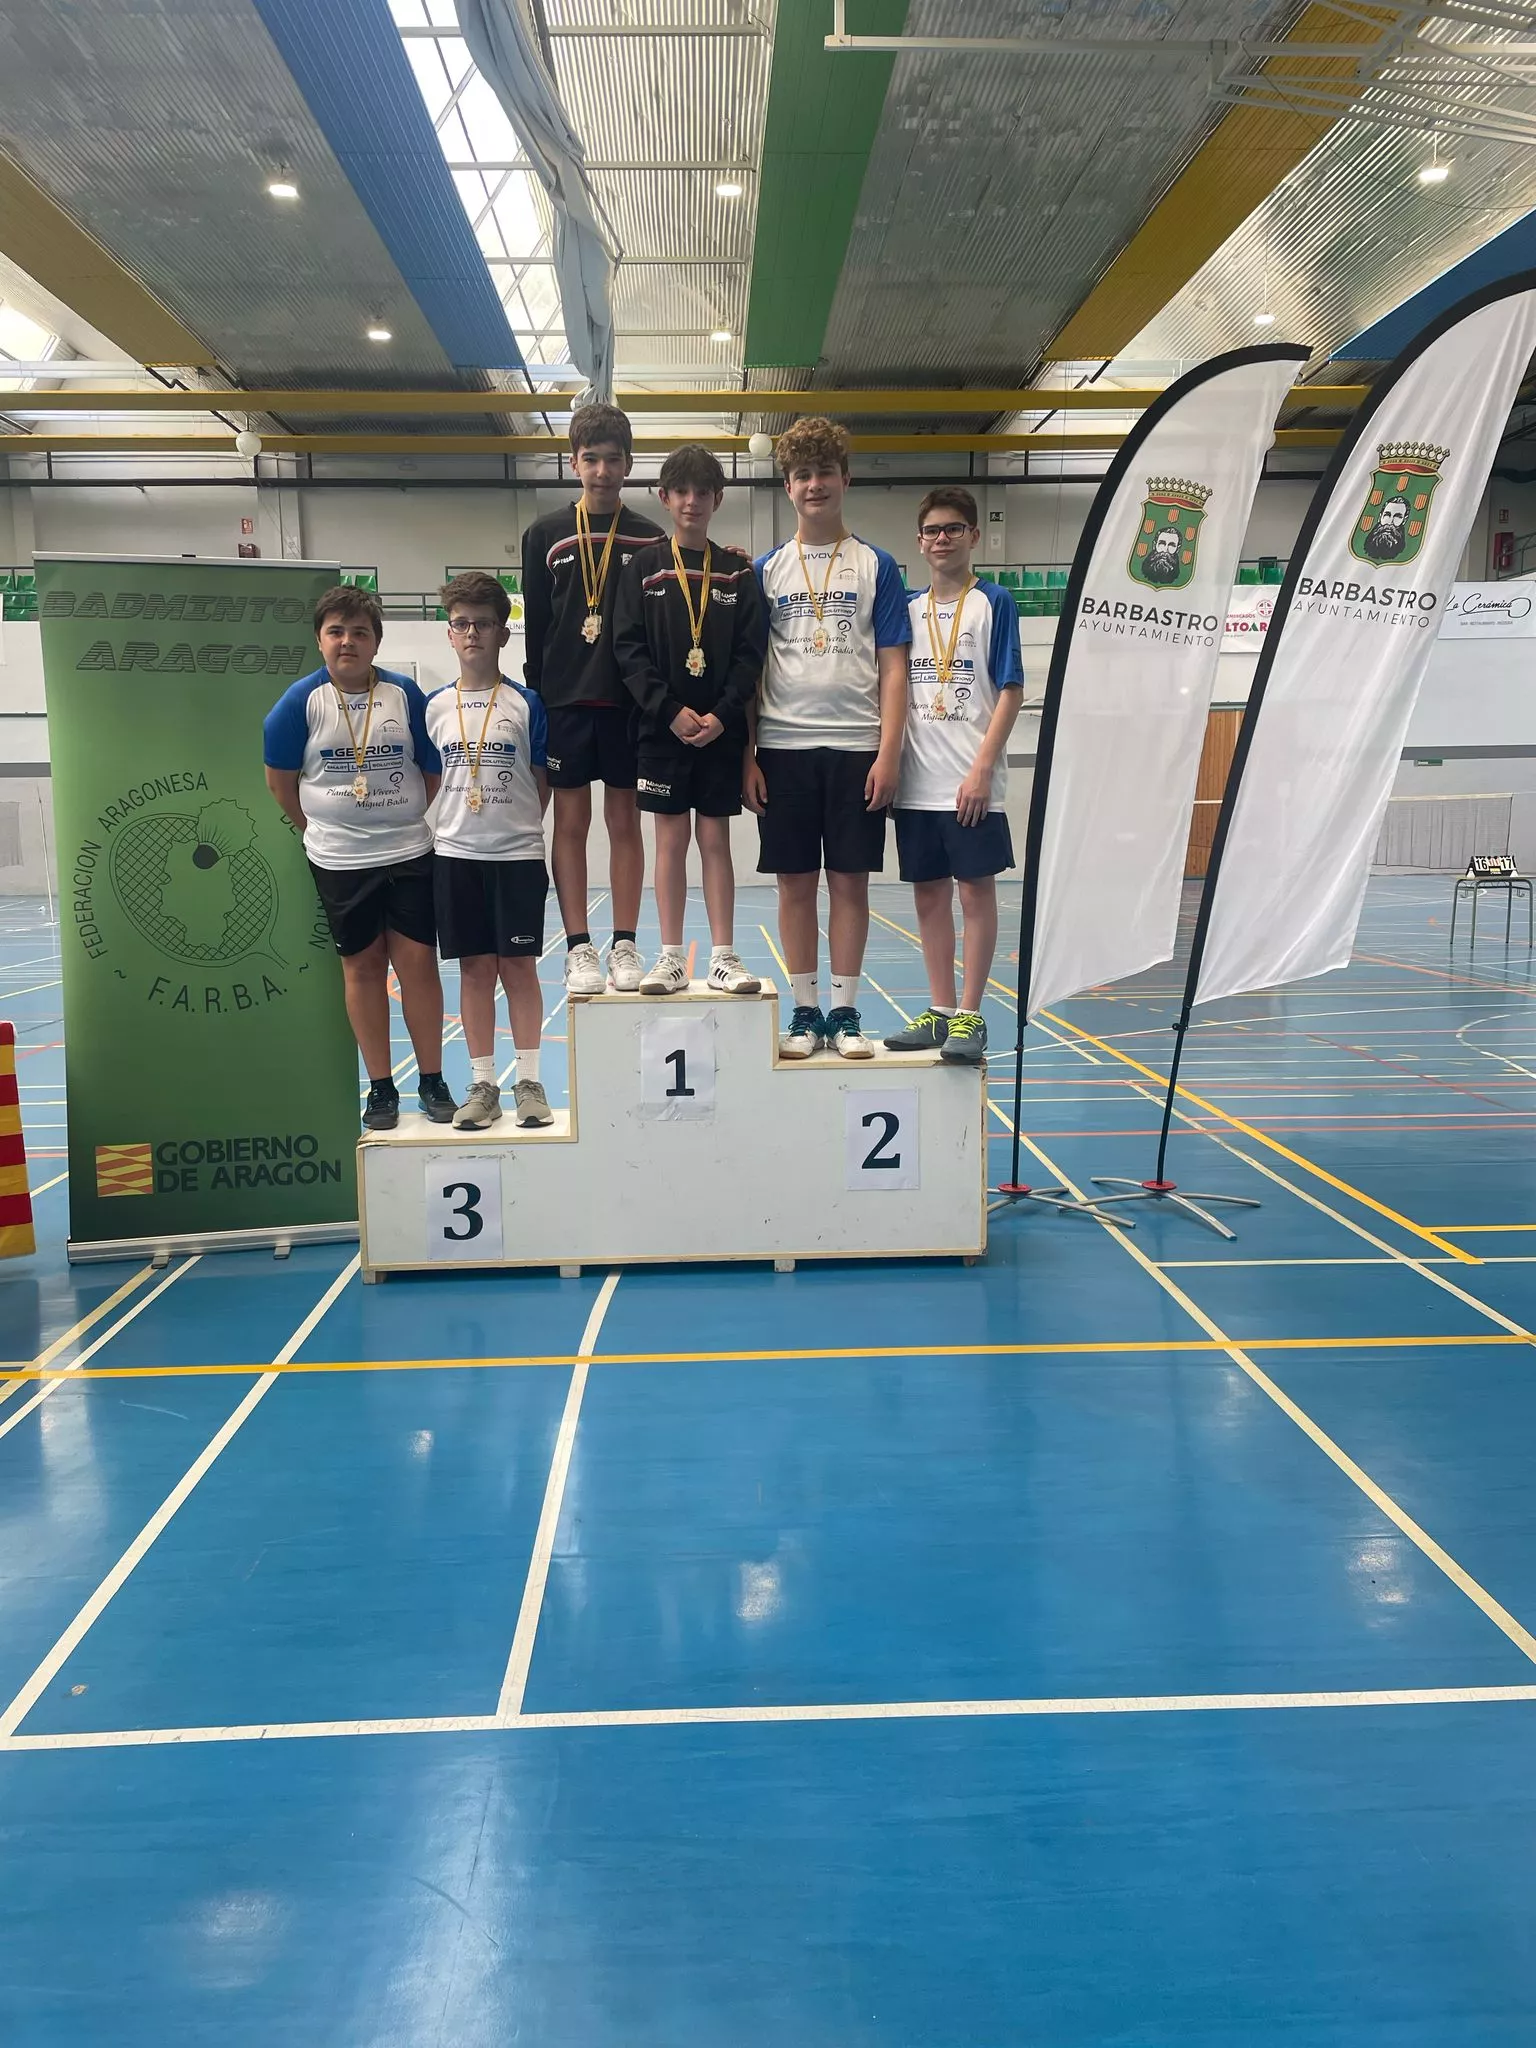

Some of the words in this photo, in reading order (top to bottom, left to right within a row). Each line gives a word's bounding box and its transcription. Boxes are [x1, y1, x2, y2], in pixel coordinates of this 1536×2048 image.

[1298, 577, 1437, 611] BARBASTRO
[1081, 597, 1218, 632] BARBASTRO
[1294, 600, 1430, 628] AYUNTAMIENTO
[1079, 619, 1215, 647] AYUNTAMIENTO
[76, 640, 306, 675] ARAGON
[913, 658, 964, 669] GECIO
[97, 771, 209, 834] ARAGONESA
[372, 787, 400, 796] Viveros
[1475, 859, 1488, 870] 16
[1501, 858, 1512, 870] 17
[73, 839, 109, 960] FEDERACION
[664, 1049, 696, 1097] 1
[156, 1134, 319, 1166] GOBIERNO
[861, 1111, 901, 1169] 2
[157, 1168, 199, 1194] DE
[210, 1159, 342, 1190] ARAGON
[442, 1182, 484, 1241] 3
